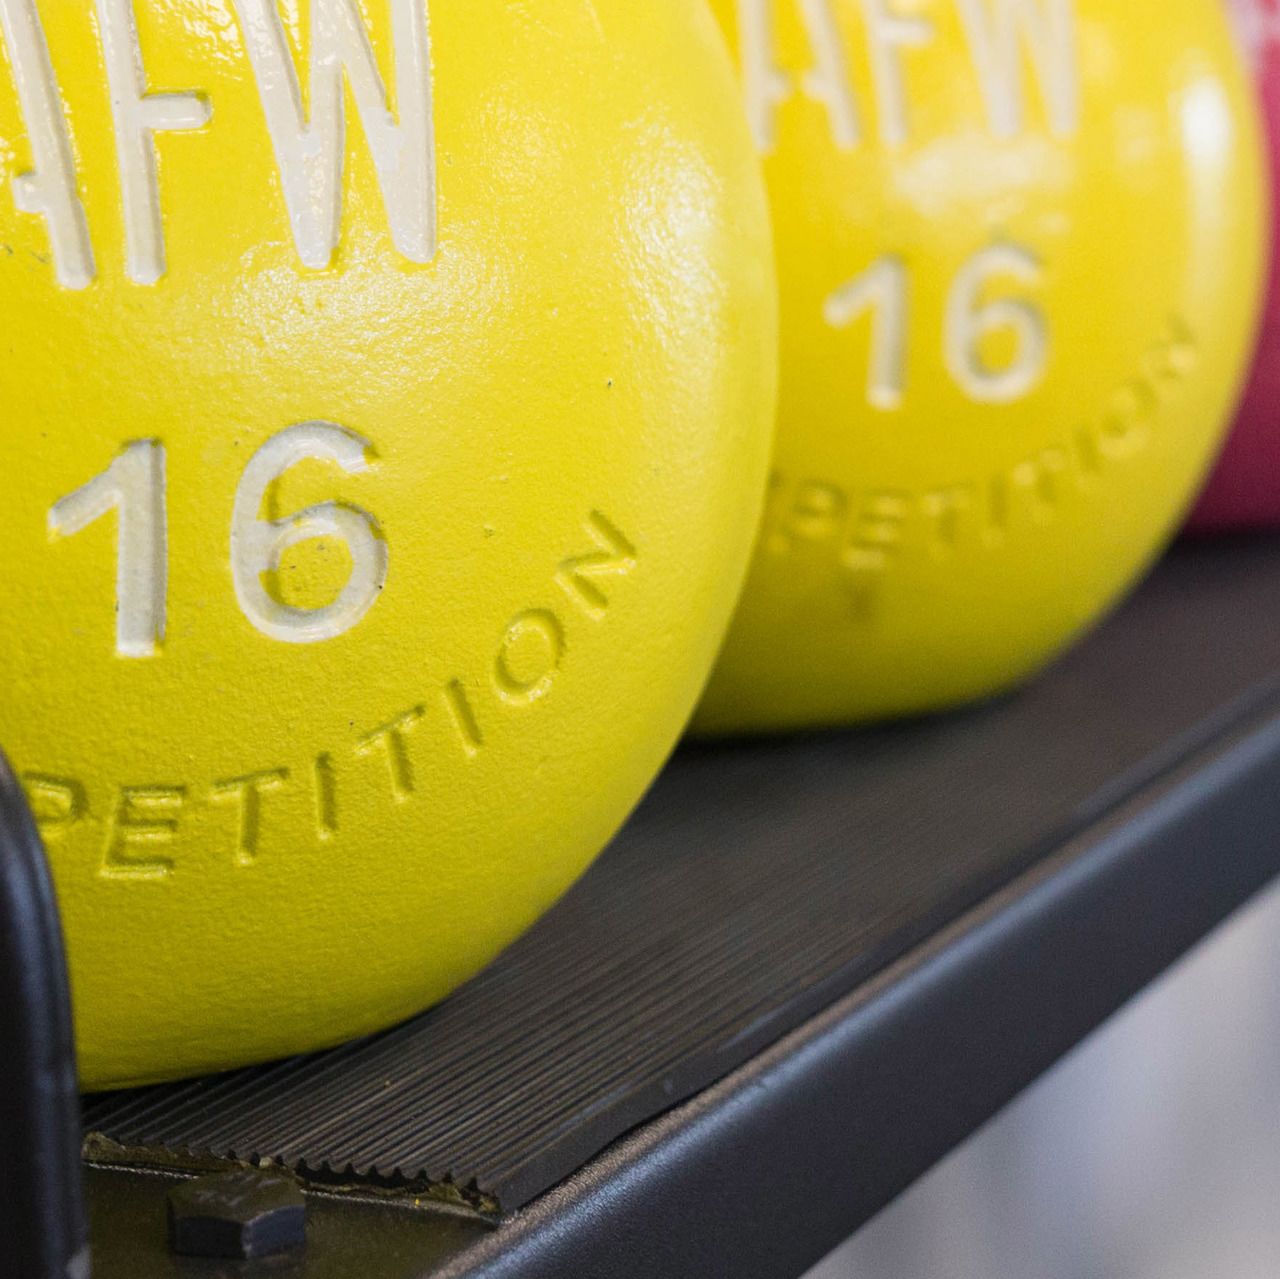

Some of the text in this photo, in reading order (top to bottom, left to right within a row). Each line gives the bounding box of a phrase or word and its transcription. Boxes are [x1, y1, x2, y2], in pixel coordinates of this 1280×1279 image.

[766, 312, 1198, 572] PETITION
[825, 242, 1047, 411] 16
[47, 420, 388, 658] 16
